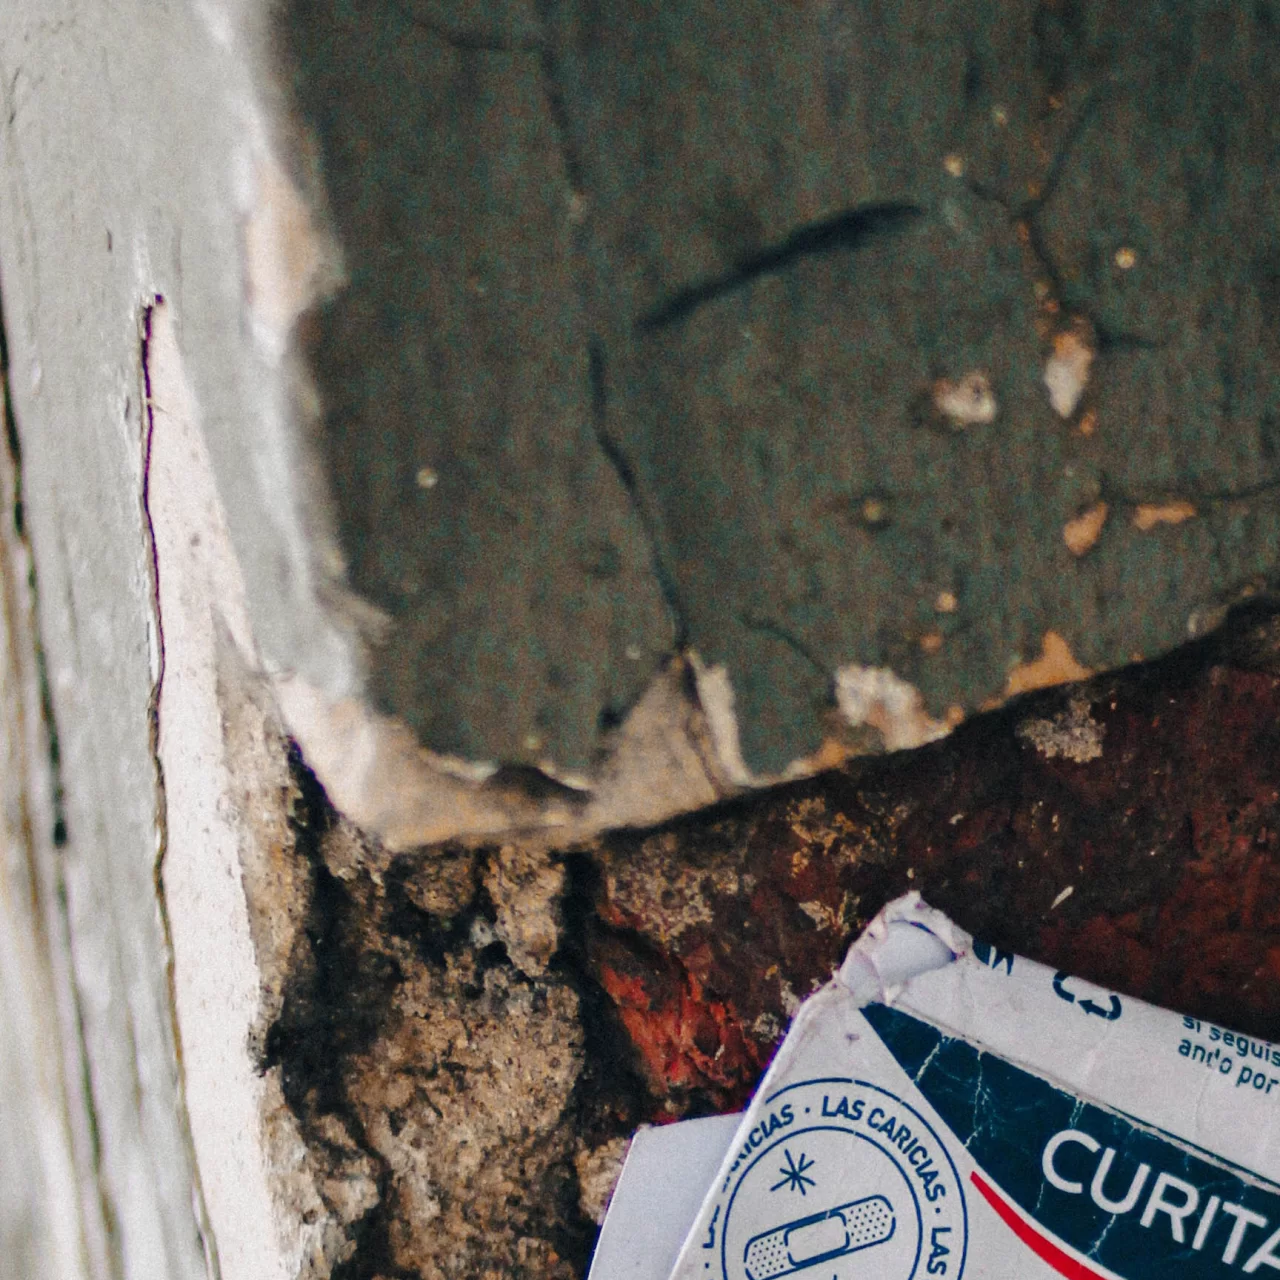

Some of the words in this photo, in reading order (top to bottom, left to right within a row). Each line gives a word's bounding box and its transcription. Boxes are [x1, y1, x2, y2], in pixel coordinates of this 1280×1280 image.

[1236, 1066, 1279, 1094] por
[821, 1096, 865, 1120] LAS
[867, 1107, 946, 1202] CARICIAS
[926, 1227, 952, 1276] LAS
